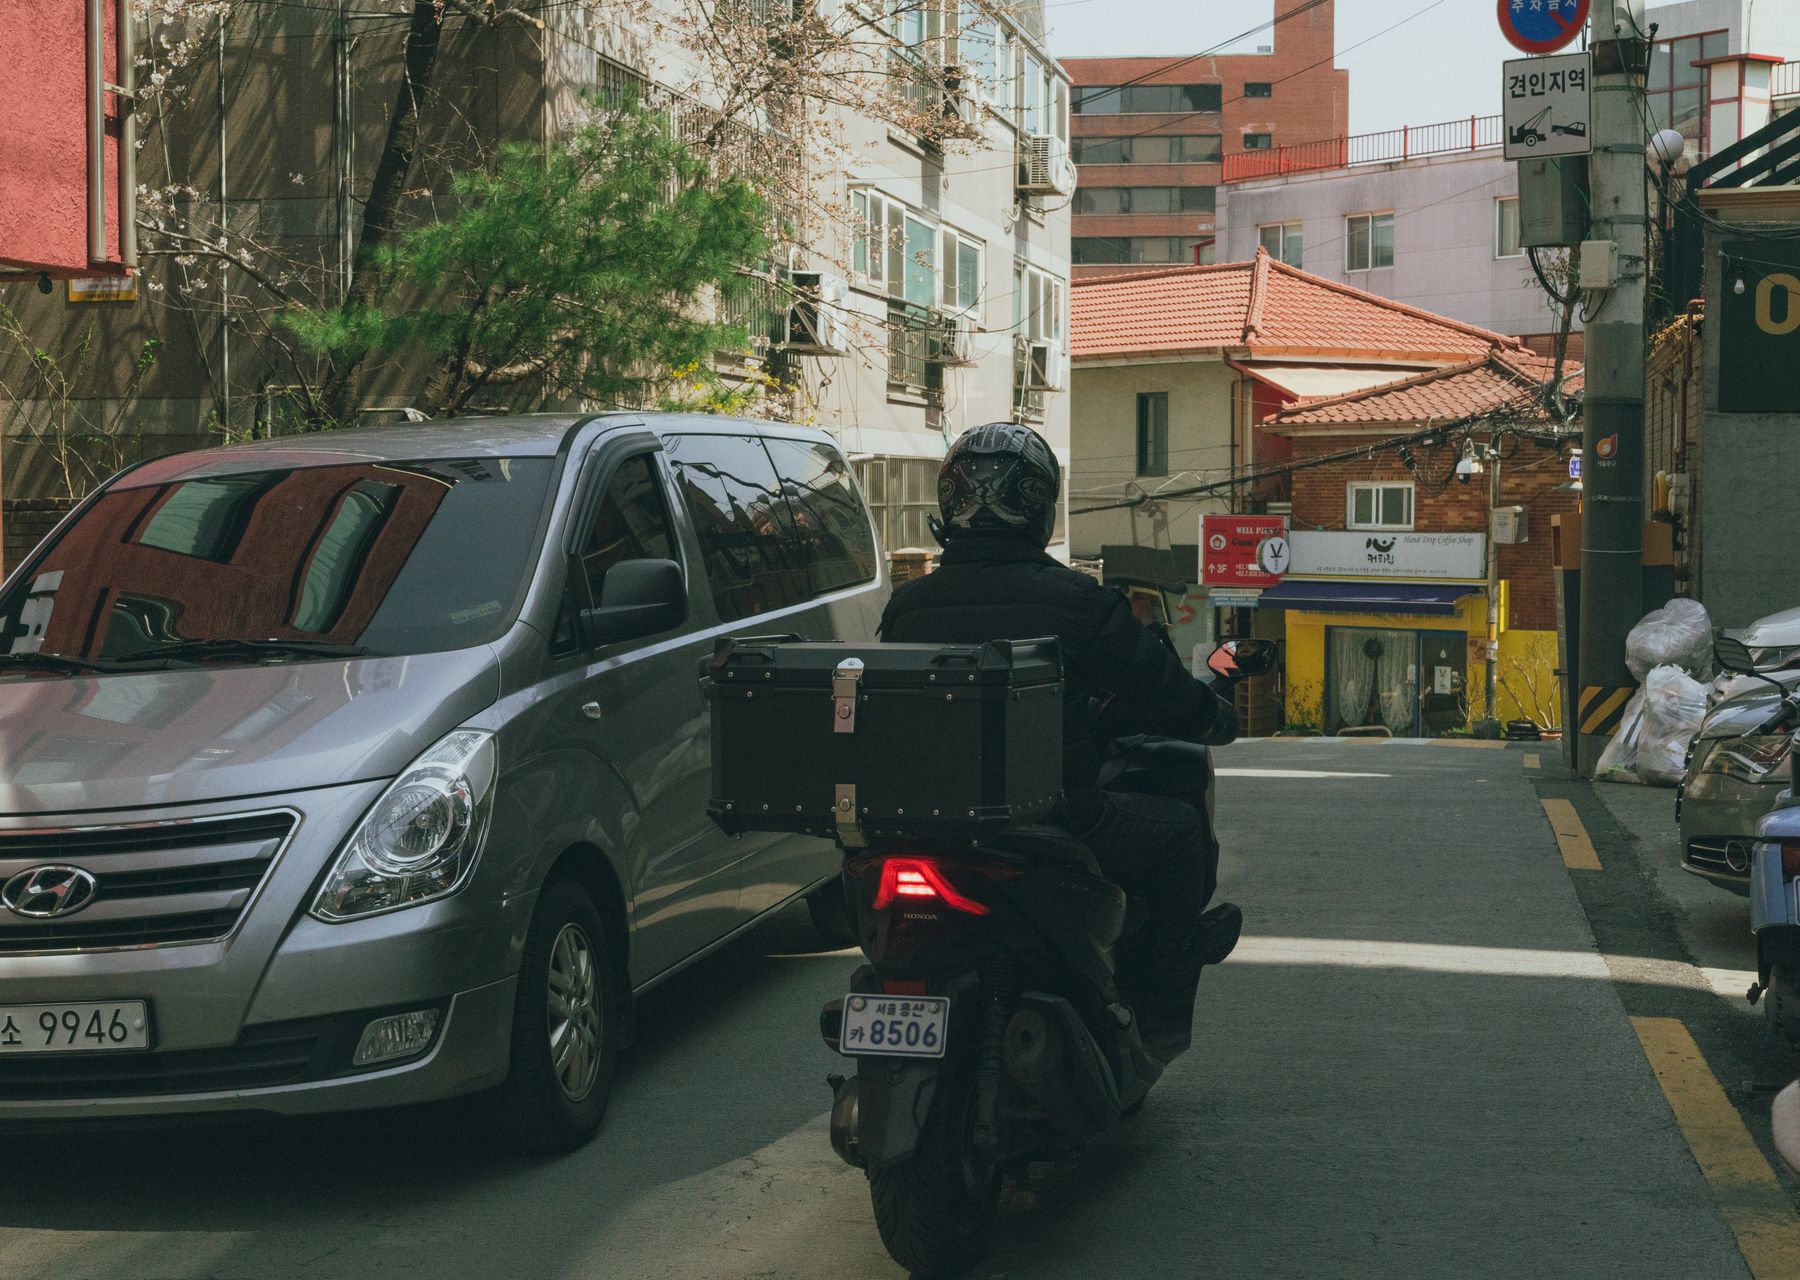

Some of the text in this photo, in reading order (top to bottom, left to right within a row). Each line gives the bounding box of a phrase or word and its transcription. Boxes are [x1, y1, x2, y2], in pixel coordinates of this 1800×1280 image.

[1508, 67, 1586, 99] 견인지역
[1236, 526, 1254, 535] WELL
[1423, 535, 1436, 546] Drip
[1437, 535, 1457, 546] Coffee
[1457, 534, 1474, 546] Shop
[1367, 553, 1395, 565] 커피집
[1216, 564, 1228, 573] 3F
[903, 912, 938, 921] HONDA
[875, 1002, 925, 1018] 서울 용산
[0, 1008, 128, 1045] 소 9946
[849, 1019, 938, 1047] 카 8506
